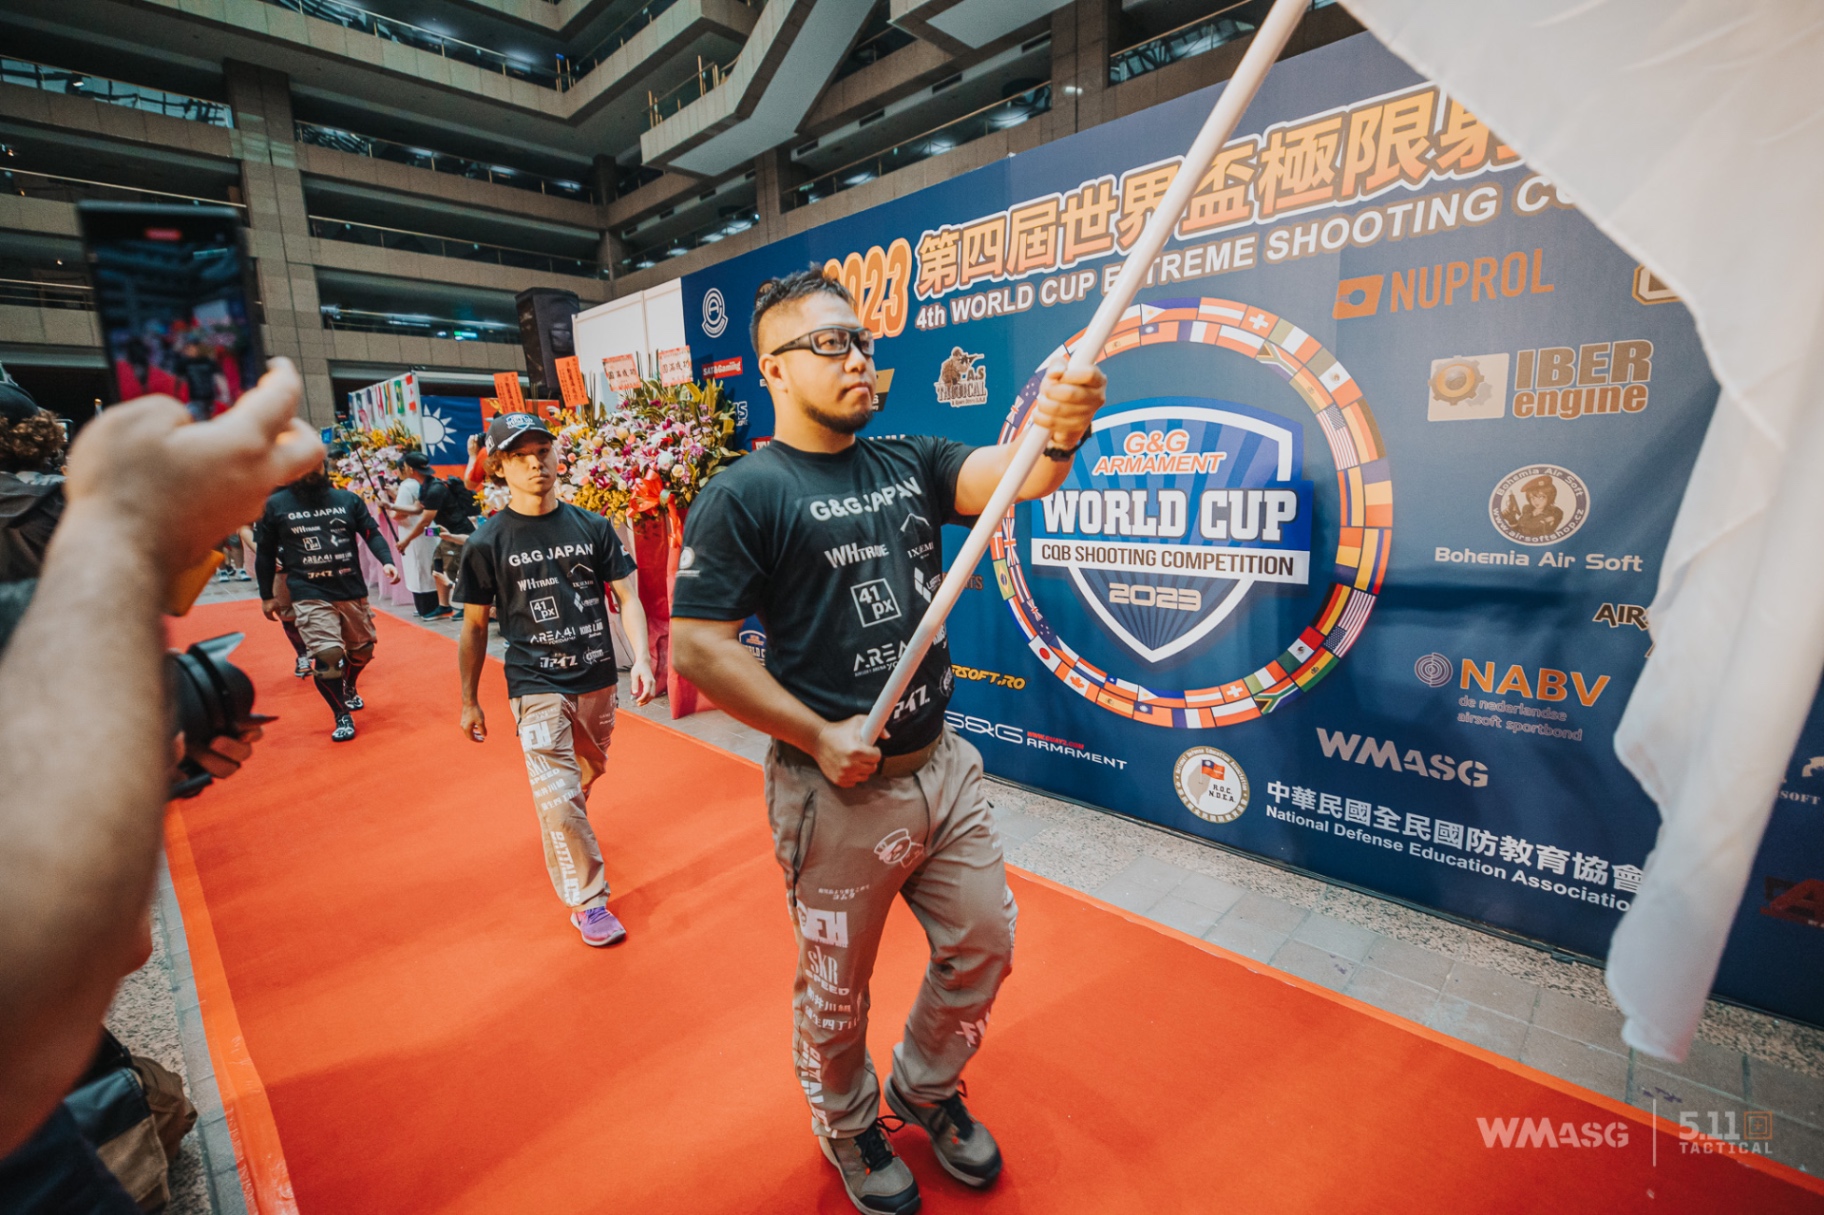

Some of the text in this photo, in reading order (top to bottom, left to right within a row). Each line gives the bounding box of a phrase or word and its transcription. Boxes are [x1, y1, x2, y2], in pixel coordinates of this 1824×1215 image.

[916, 306, 946, 329] 4th
[951, 285, 1033, 323] WORLD
[1041, 271, 1096, 305] CUP
[1104, 236, 1256, 294] ETREME
[1267, 186, 1498, 260] SHOOTING
[1390, 248, 1555, 313] NUPROL
[1514, 339, 1654, 391] IBER
[1512, 384, 1649, 420] engine
[1123, 428, 1191, 455] G&G
[1092, 451, 1226, 476] ARMAMENT
[1496, 467, 1585, 497] Bohemia Air Soft
[287, 506, 347, 520] G&G JAPAN
[809, 496, 863, 521] G&G
[1041, 487, 1297, 542] WORLD CUP
[508, 543, 594, 567] G&G JAPAN
[1041, 543, 1295, 577] CQB SHOOTING COMPETITION
[1434, 547, 1644, 572] Bohemia Air Soft
[533, 601, 547, 611] 41
[859, 584, 881, 604] 41
[871, 598, 895, 620] px
[1108, 582, 1202, 612] 2023
[1593, 603, 1649, 631] AIR
[1460, 658, 1611, 707] NABV
[1458, 695, 1568, 722] de nederlandse
[1457, 712, 1583, 742] airsoft sportbond
[1026, 738, 1128, 770] ARMAMENT
[1316, 727, 1489, 788] WMASG
[1267, 780, 1645, 894] 中華民國全民國防教育協會
[1266, 804, 1631, 912] National Defense Education Associatio
